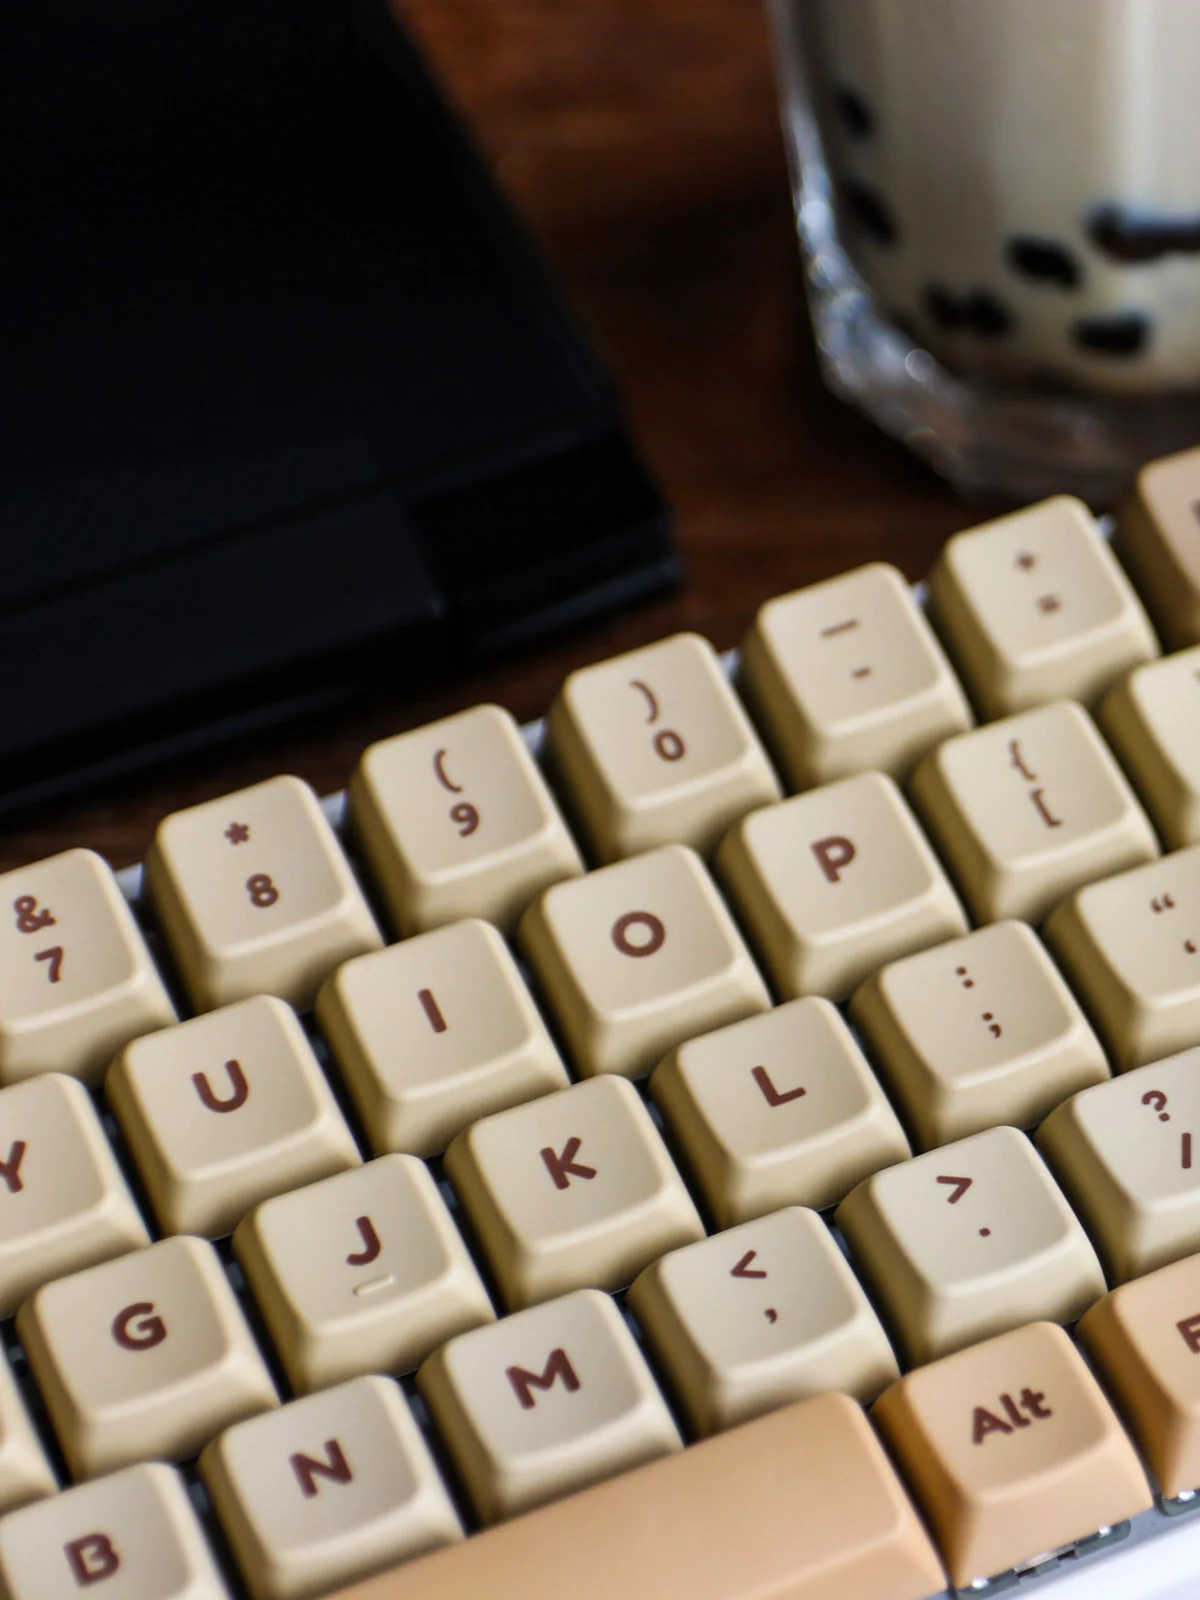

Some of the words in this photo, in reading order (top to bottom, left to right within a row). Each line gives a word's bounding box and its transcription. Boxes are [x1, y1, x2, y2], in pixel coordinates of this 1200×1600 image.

[1015, 552, 1037, 573] +
[630, 680, 660, 724] )
[433, 749, 463, 794] (
[1008, 740, 1037, 782] {
[451, 803, 479, 837] 9
[1030, 788, 1062, 829] [
[811, 836, 856, 883] P
[247, 874, 279, 908] 8
[14, 896, 56, 933] &
[612, 912, 665, 957] O
[35, 946, 63, 983] 7
[955, 966, 974, 989] :
[418, 989, 447, 1033] I
[981, 1012, 1002, 1039] ;
[192, 1060, 248, 1113] U
[752, 1066, 806, 1107] L
[1141, 1090, 1171, 1123] ?
[540, 1137, 597, 1190] K
[936, 1175, 973, 1205] >
[347, 1216, 381, 1266] J
[978, 1227, 991, 1238] .
[730, 1249, 768, 1280] <
[112, 1303, 167, 1351] G
[506, 1349, 580, 1409] M
[973, 1388, 1052, 1444] Alt
[290, 1440, 353, 1497] N
[65, 1534, 119, 1586] B
